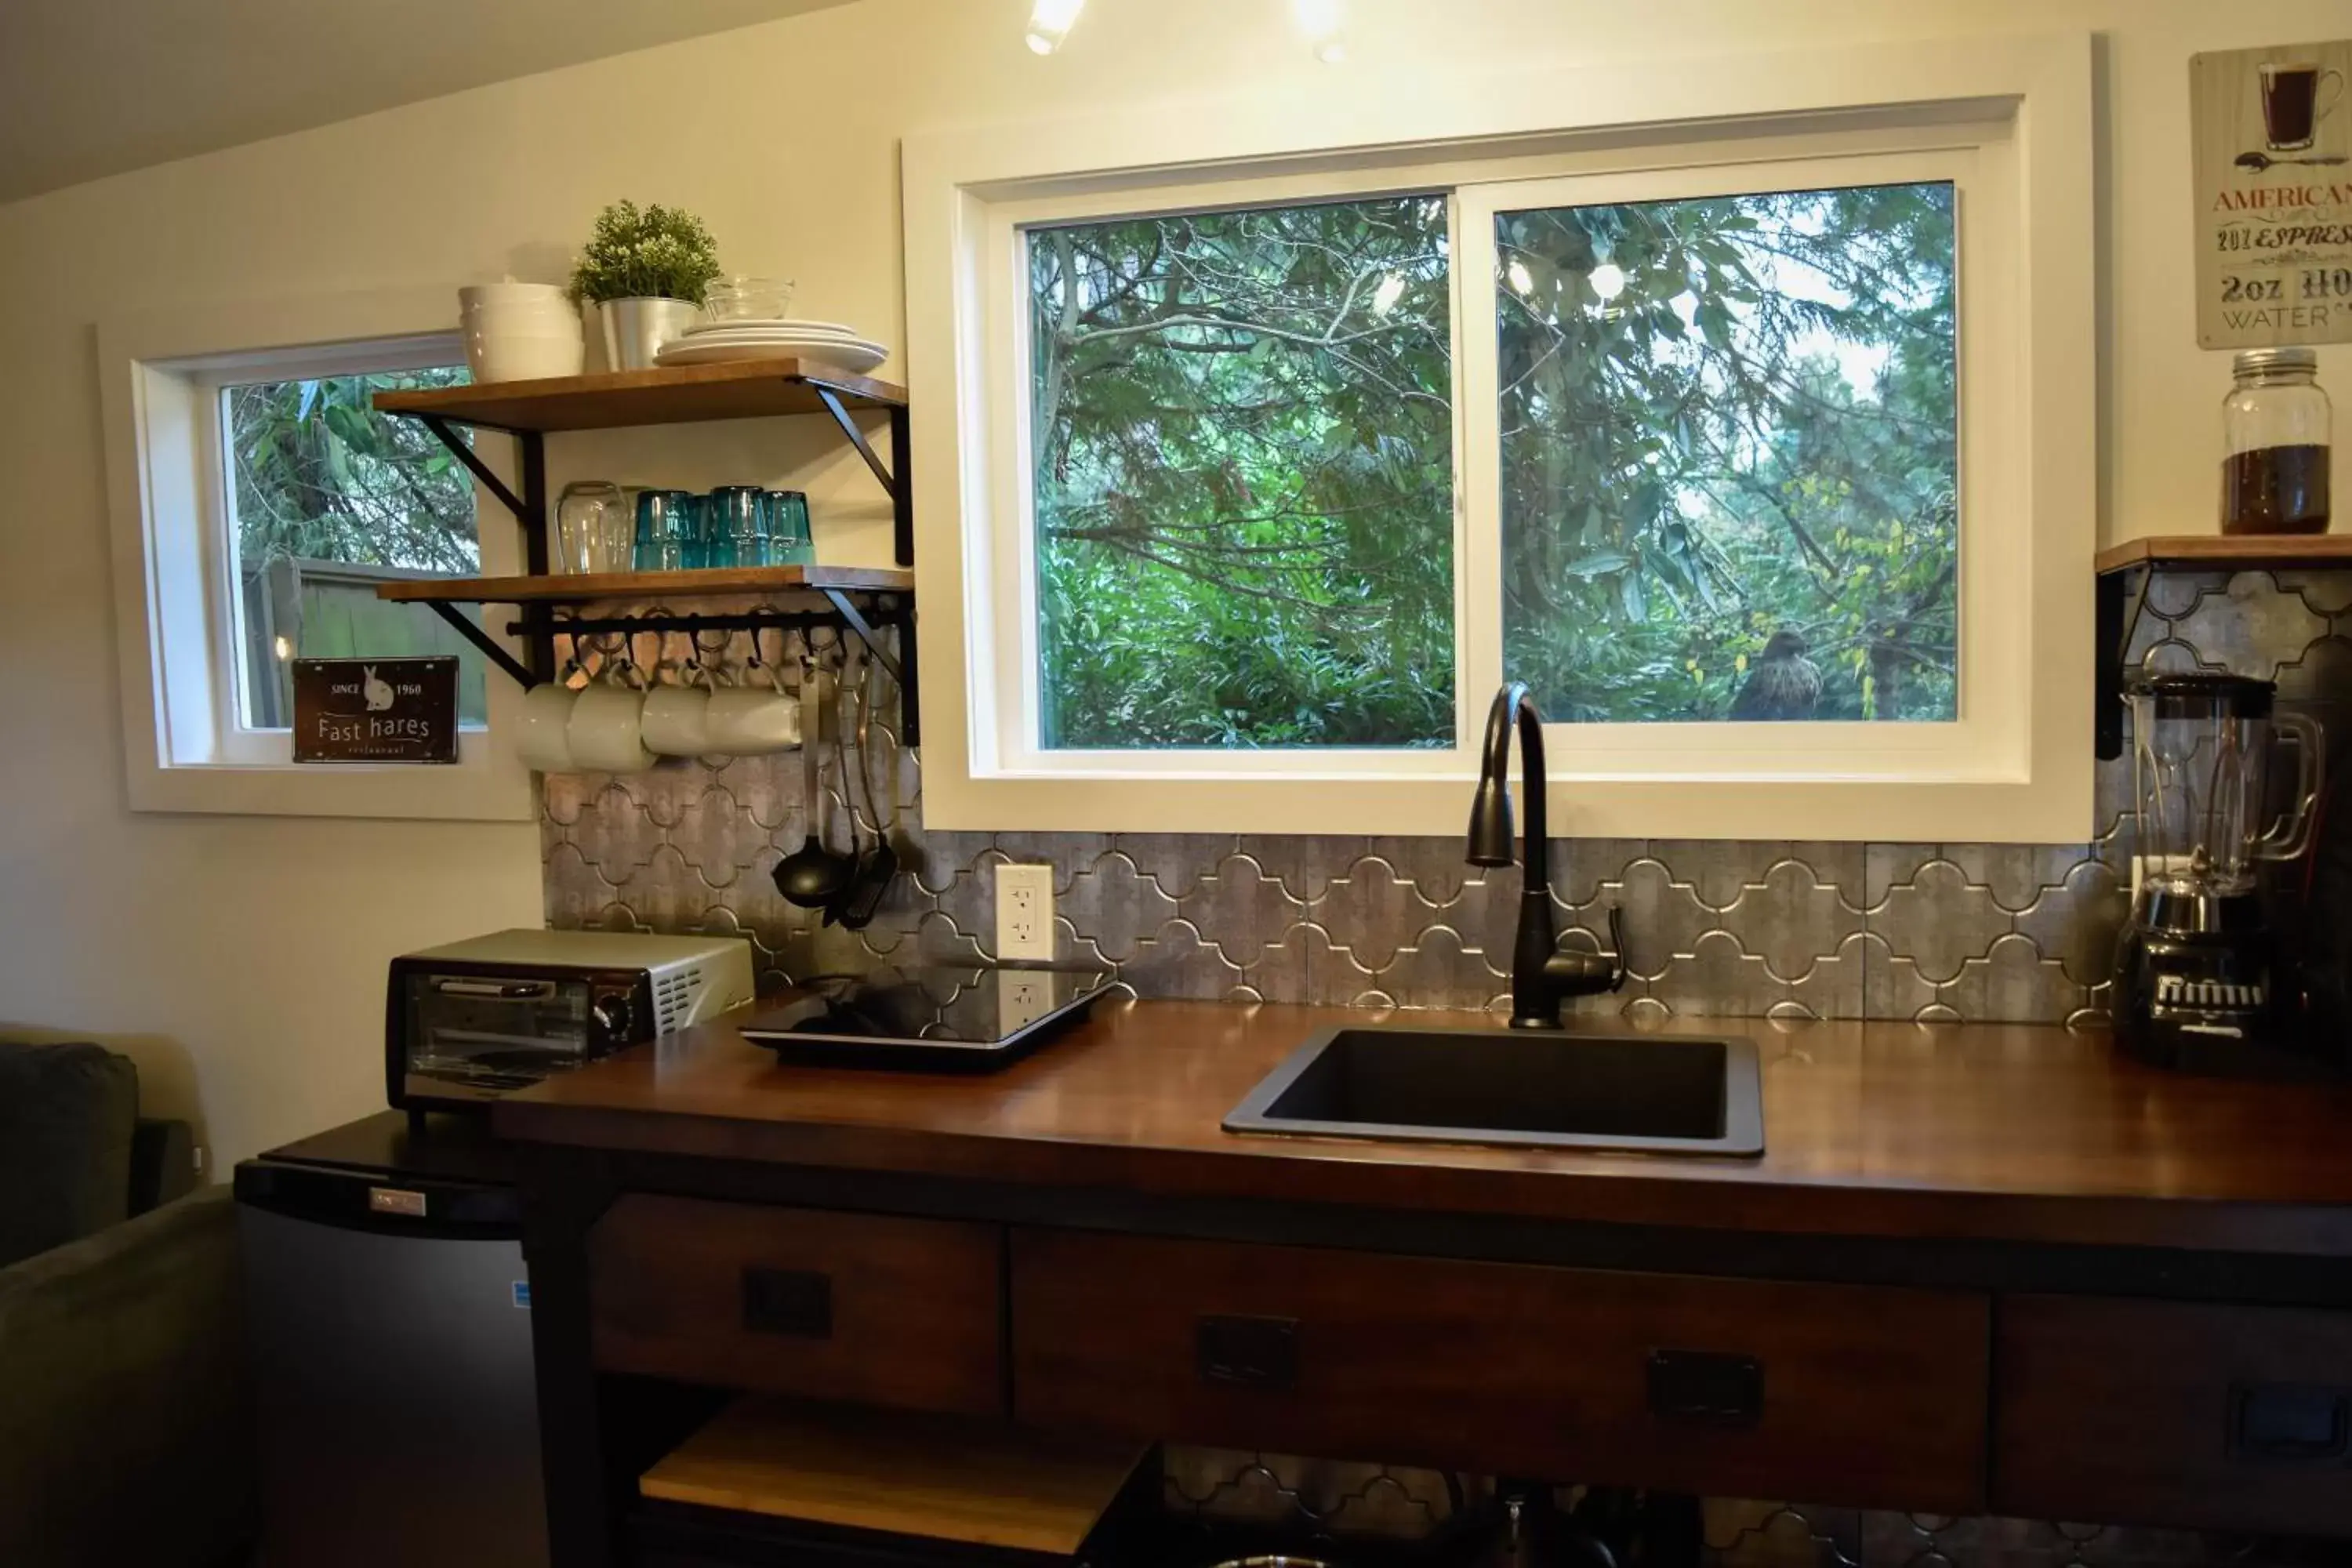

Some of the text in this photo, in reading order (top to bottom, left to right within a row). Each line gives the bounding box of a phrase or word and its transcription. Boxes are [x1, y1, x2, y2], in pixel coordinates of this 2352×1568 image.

[2222, 304, 2329, 329] WATER
[331, 683, 422, 696] SINCE 1960
[318, 716, 430, 741] Fast hares
